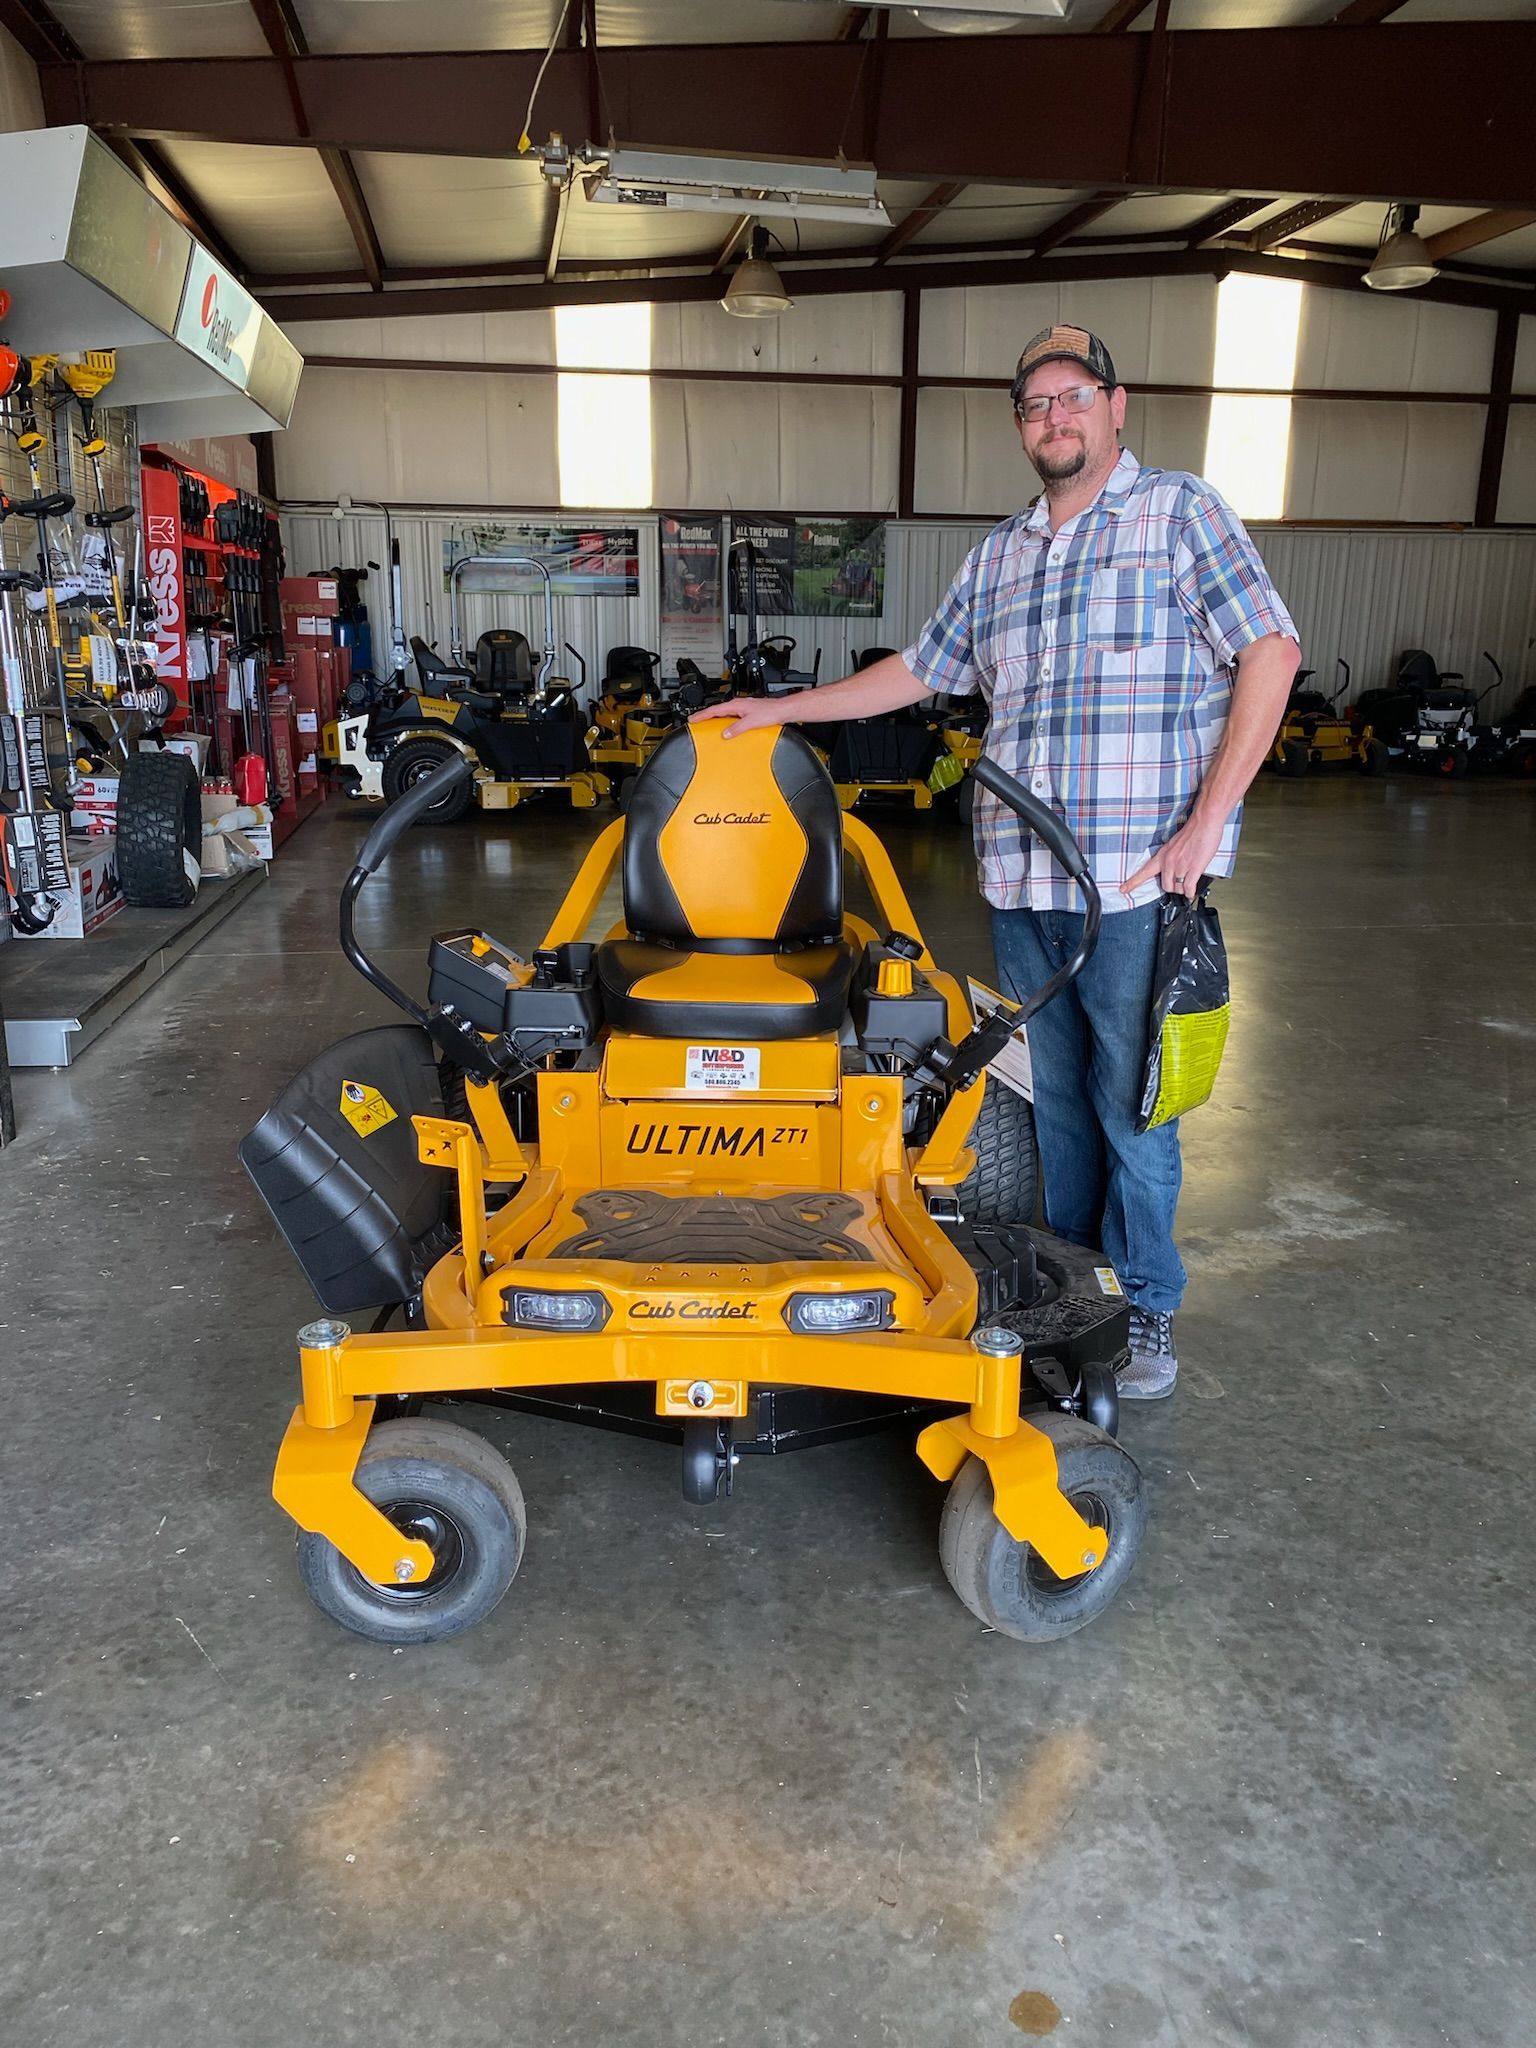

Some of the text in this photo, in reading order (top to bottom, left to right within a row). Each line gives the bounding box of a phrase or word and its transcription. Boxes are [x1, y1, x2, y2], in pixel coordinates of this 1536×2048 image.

[681, 526, 711, 540] RedMax
[736, 527, 788, 538] ALL THE POWER
[814, 535, 840, 546] RedMax
[149, 548, 182, 679] Kress
[276, 748, 291, 797] Kress
[694, 812, 771, 824] Cub Cadet
[702, 1049, 745, 1062] M&D
[626, 1124, 809, 1157] ULTIMA ZT1
[628, 1300, 757, 1319] Cub Cadet
